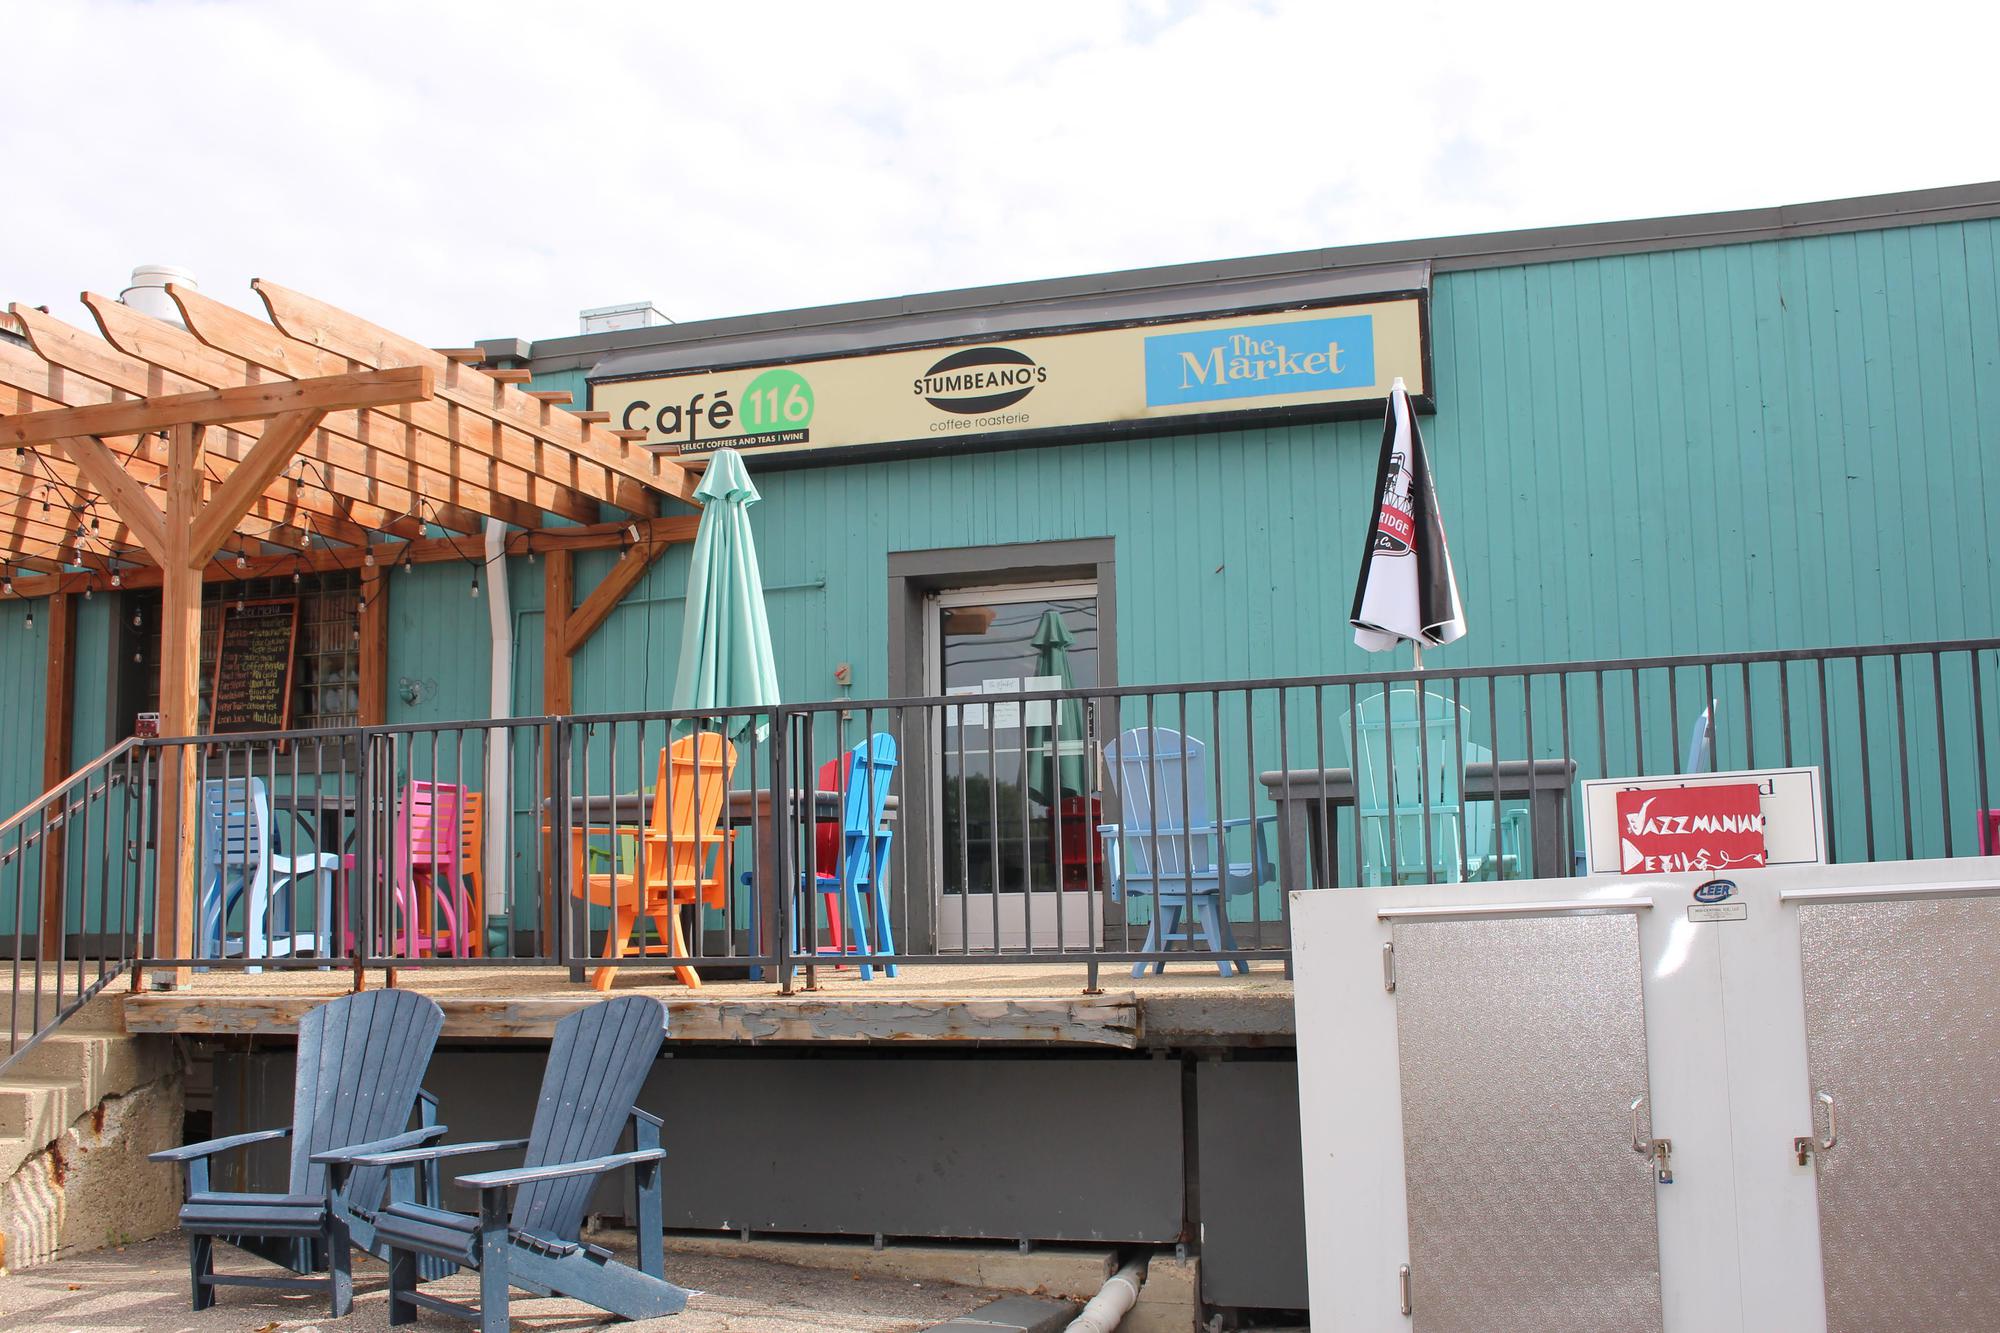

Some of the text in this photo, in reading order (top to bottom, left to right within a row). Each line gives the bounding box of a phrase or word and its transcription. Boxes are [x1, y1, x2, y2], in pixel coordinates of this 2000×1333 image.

[1229, 334, 1274, 356] The
[1177, 342, 1345, 389] Market
[913, 367, 1047, 395] STUMBEANO'S
[622, 384, 809, 441] Café 116
[930, 412, 1030, 432] coffee roasterie
[681, 442, 706, 451] SELECT
[706, 438, 737, 448] COFFEES
[738, 437, 757, 445] AND
[757, 435, 776, 443] TEAS
[782, 432, 804, 441] WINE
[1625, 796, 1764, 836] JAZZMANIAN
[1700, 884, 1730, 896] LEER
